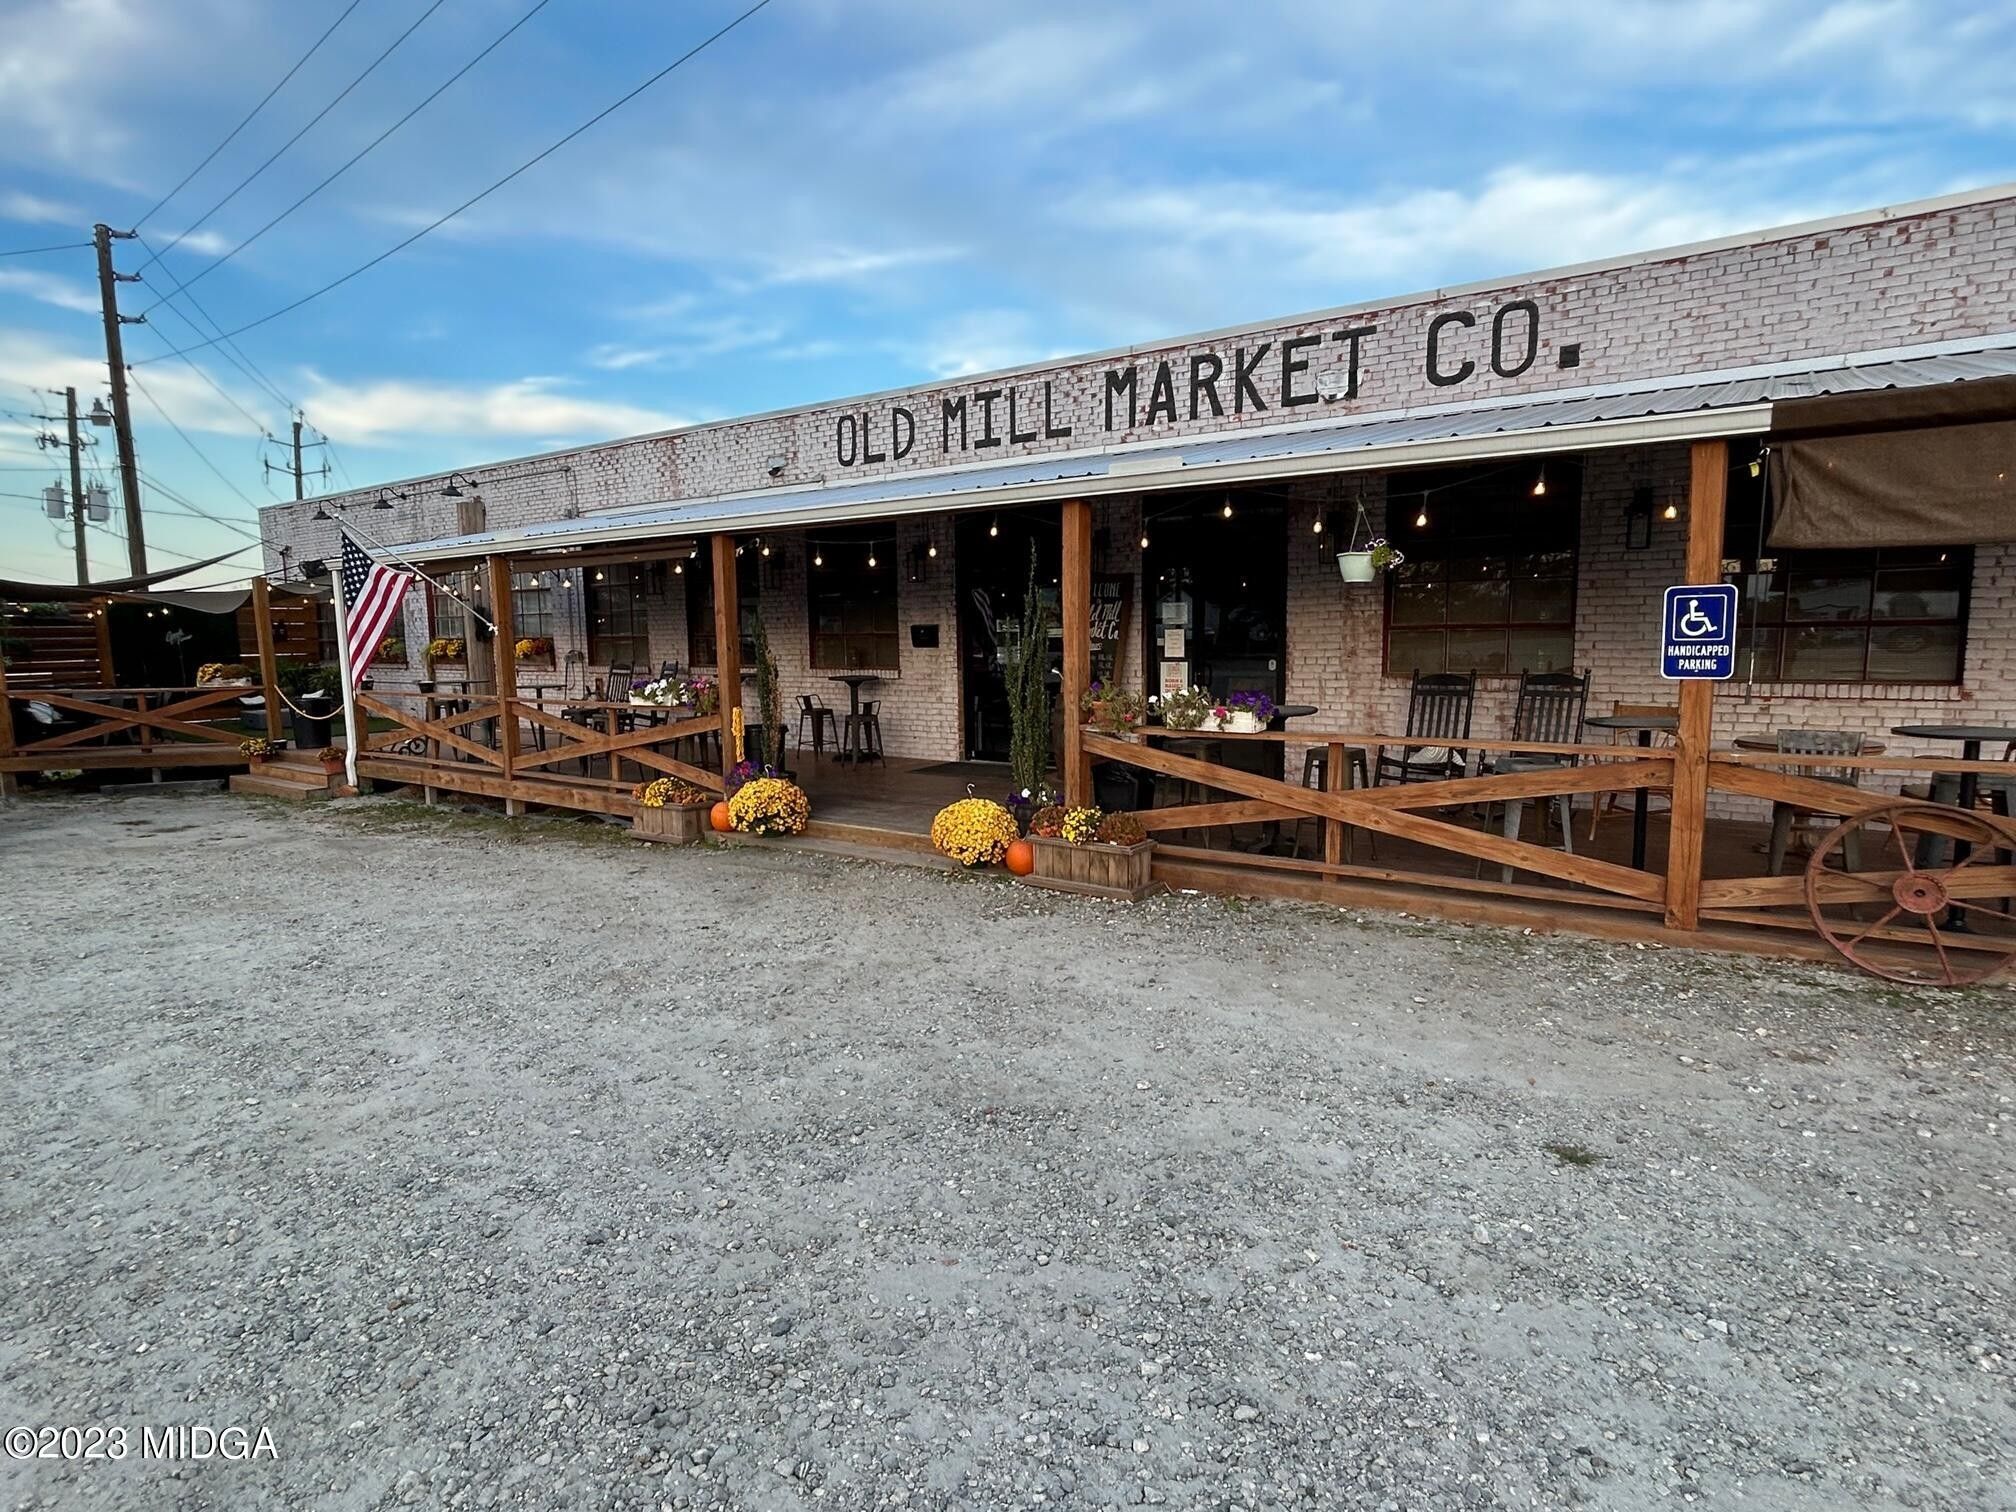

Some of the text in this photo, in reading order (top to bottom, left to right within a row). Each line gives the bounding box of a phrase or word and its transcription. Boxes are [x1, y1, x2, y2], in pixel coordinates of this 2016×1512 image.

[837, 299, 1580, 467] OLD MILL MARKET CO.
[1668, 645, 1729, 656] HANDICAPPED
[1678, 659, 1717, 670] PARKING
